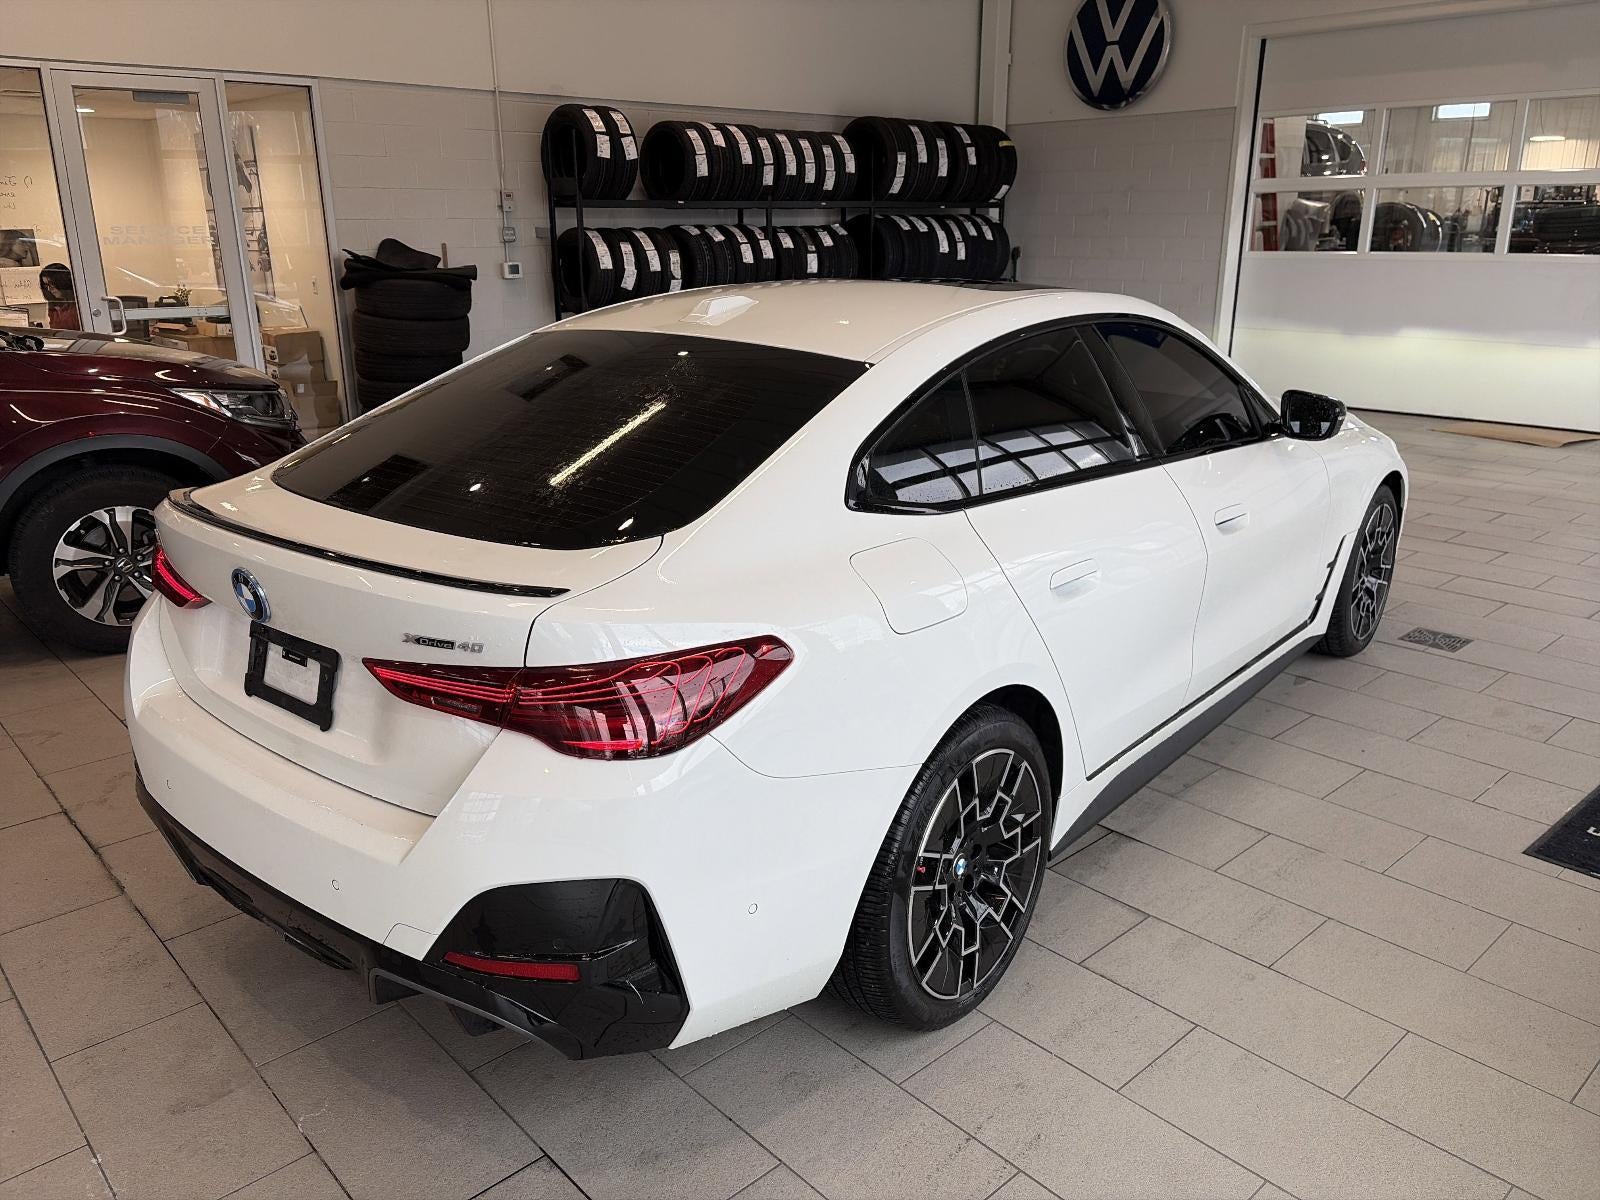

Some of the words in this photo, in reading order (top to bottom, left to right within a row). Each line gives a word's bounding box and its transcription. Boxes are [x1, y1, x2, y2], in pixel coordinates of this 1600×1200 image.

[1070, 0, 1164, 98] VW
[109, 225, 206, 236] SEICE
[102, 235, 211, 246] MANGER
[457, 640, 484, 653] 40
